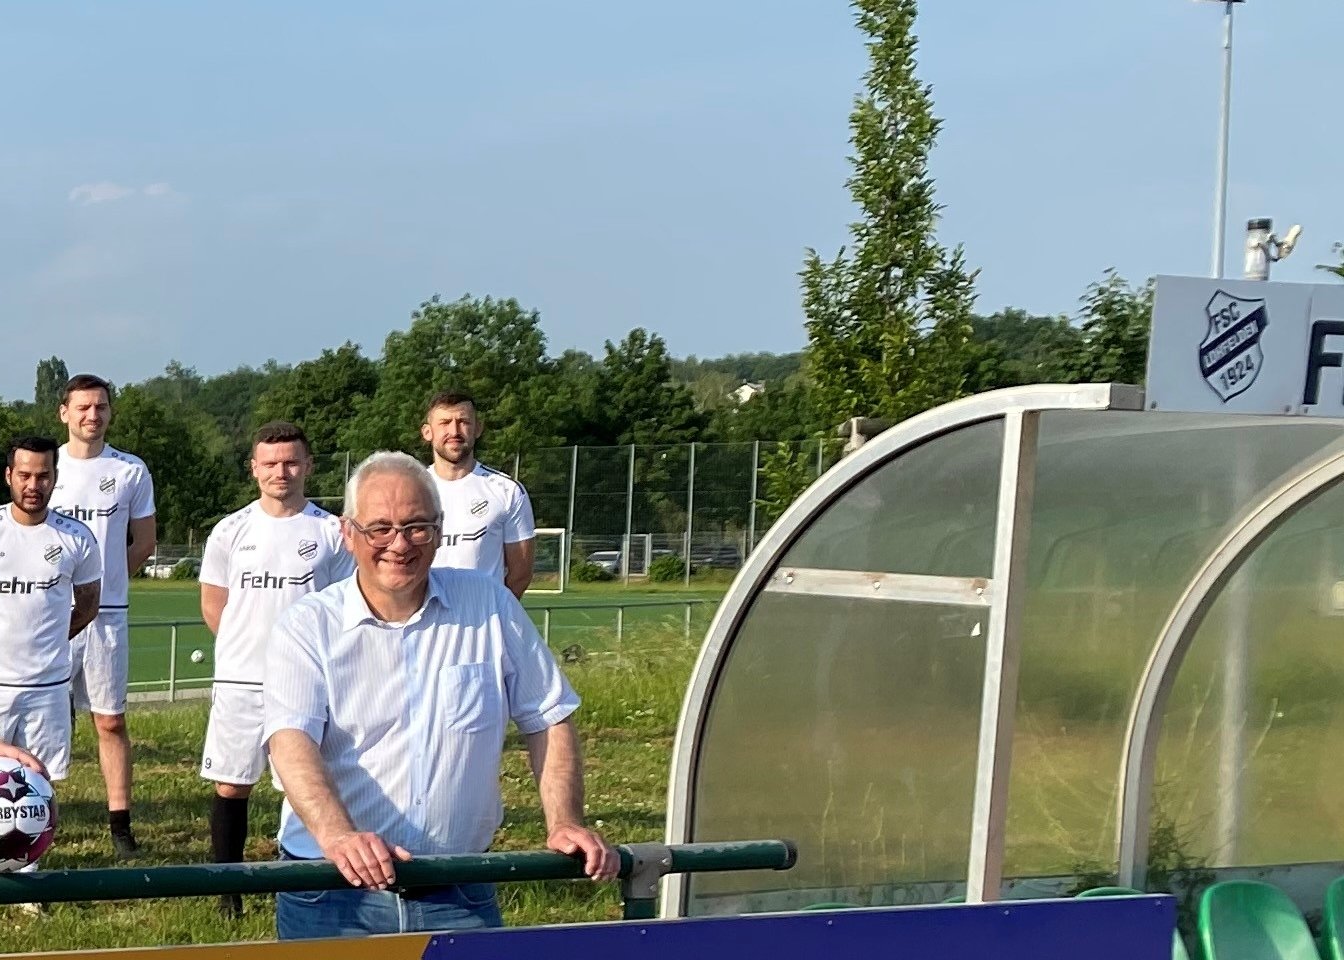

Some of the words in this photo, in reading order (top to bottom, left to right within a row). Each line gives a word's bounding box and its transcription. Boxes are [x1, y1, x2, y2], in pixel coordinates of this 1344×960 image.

[1212, 302, 1240, 333] FSC
[1220, 354, 1254, 390] 1924
[1302, 320, 1344, 405] F
[240, 571, 287, 589] Fehr
[205, 757, 212, 769] 9
